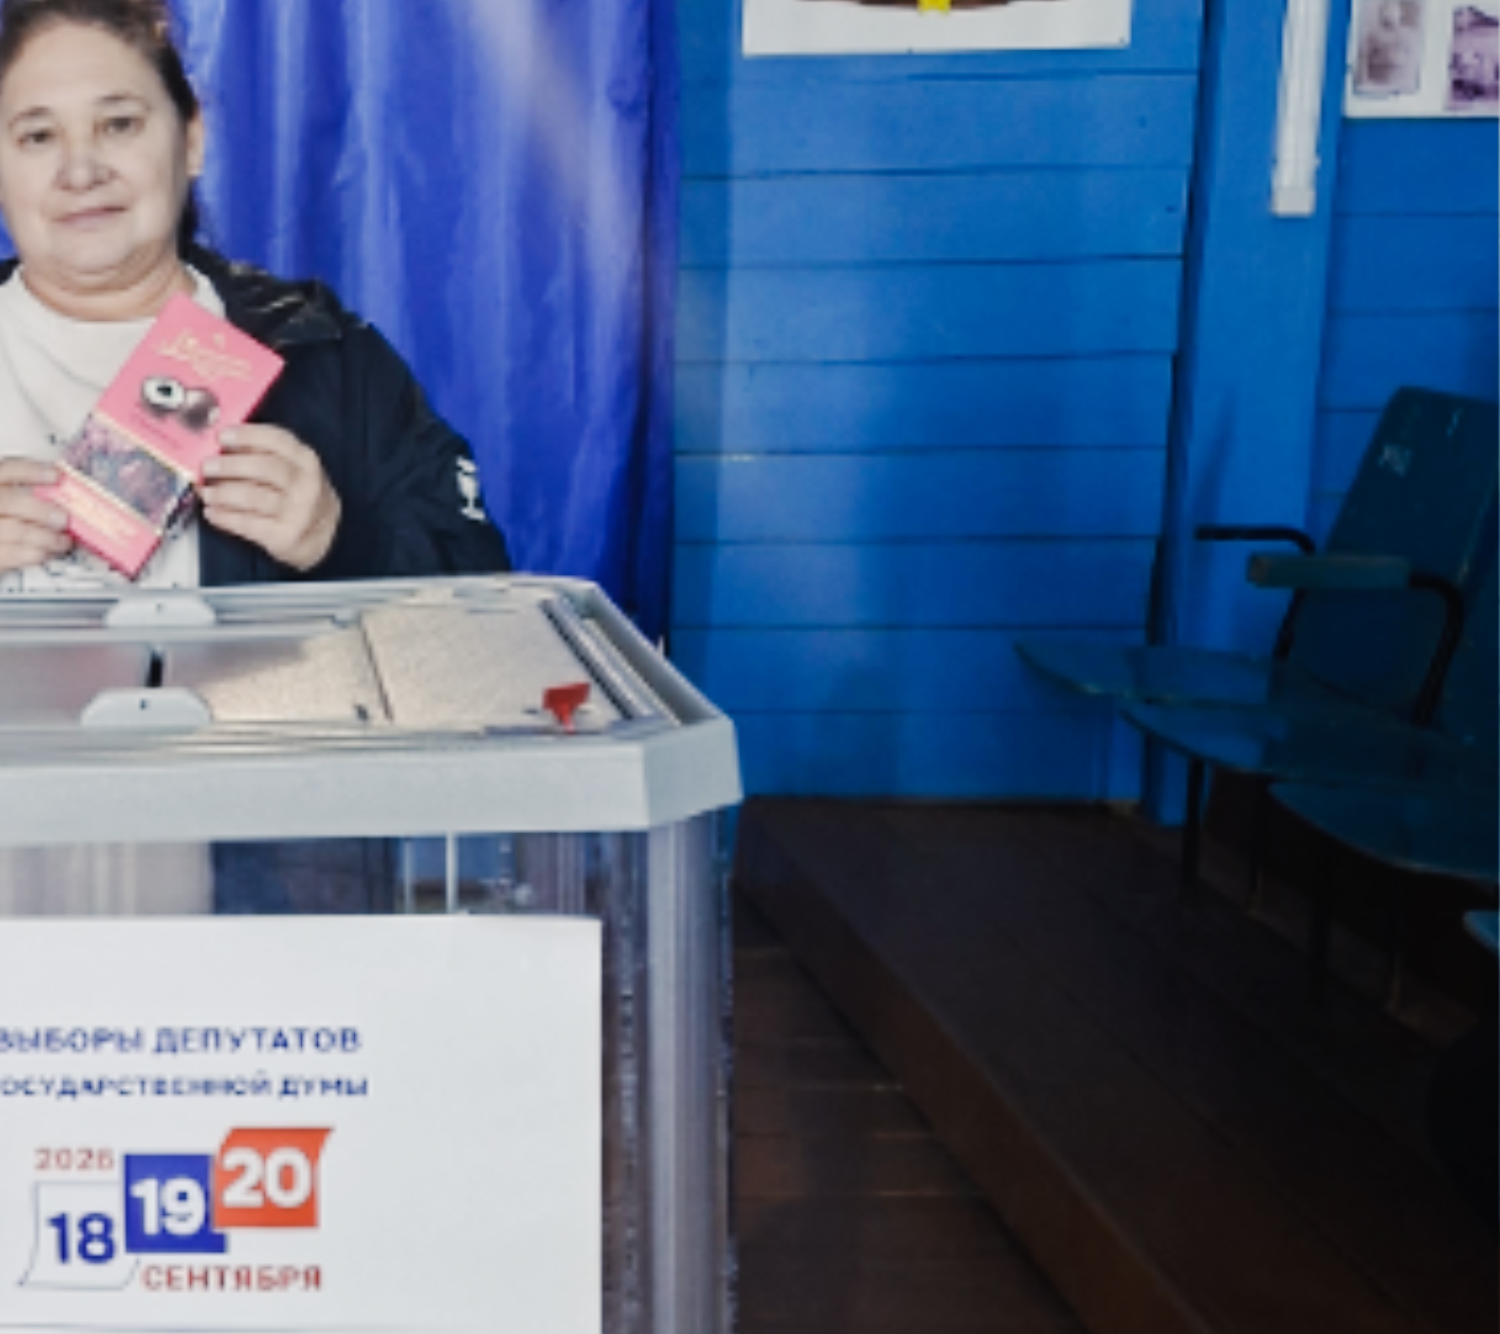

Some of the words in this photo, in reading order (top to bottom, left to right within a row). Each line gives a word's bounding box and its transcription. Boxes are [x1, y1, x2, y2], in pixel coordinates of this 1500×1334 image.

[152, 1026, 362, 1058] ДЕПУТАТОВ
[277, 1077, 370, 1100] ДУМЫ
[47, 1212, 116, 1264] 18
[129, 1176, 206, 1237] 19
[222, 1146, 314, 1209] 20
[141, 1266, 323, 1292] СЕНТЯБРЯ
